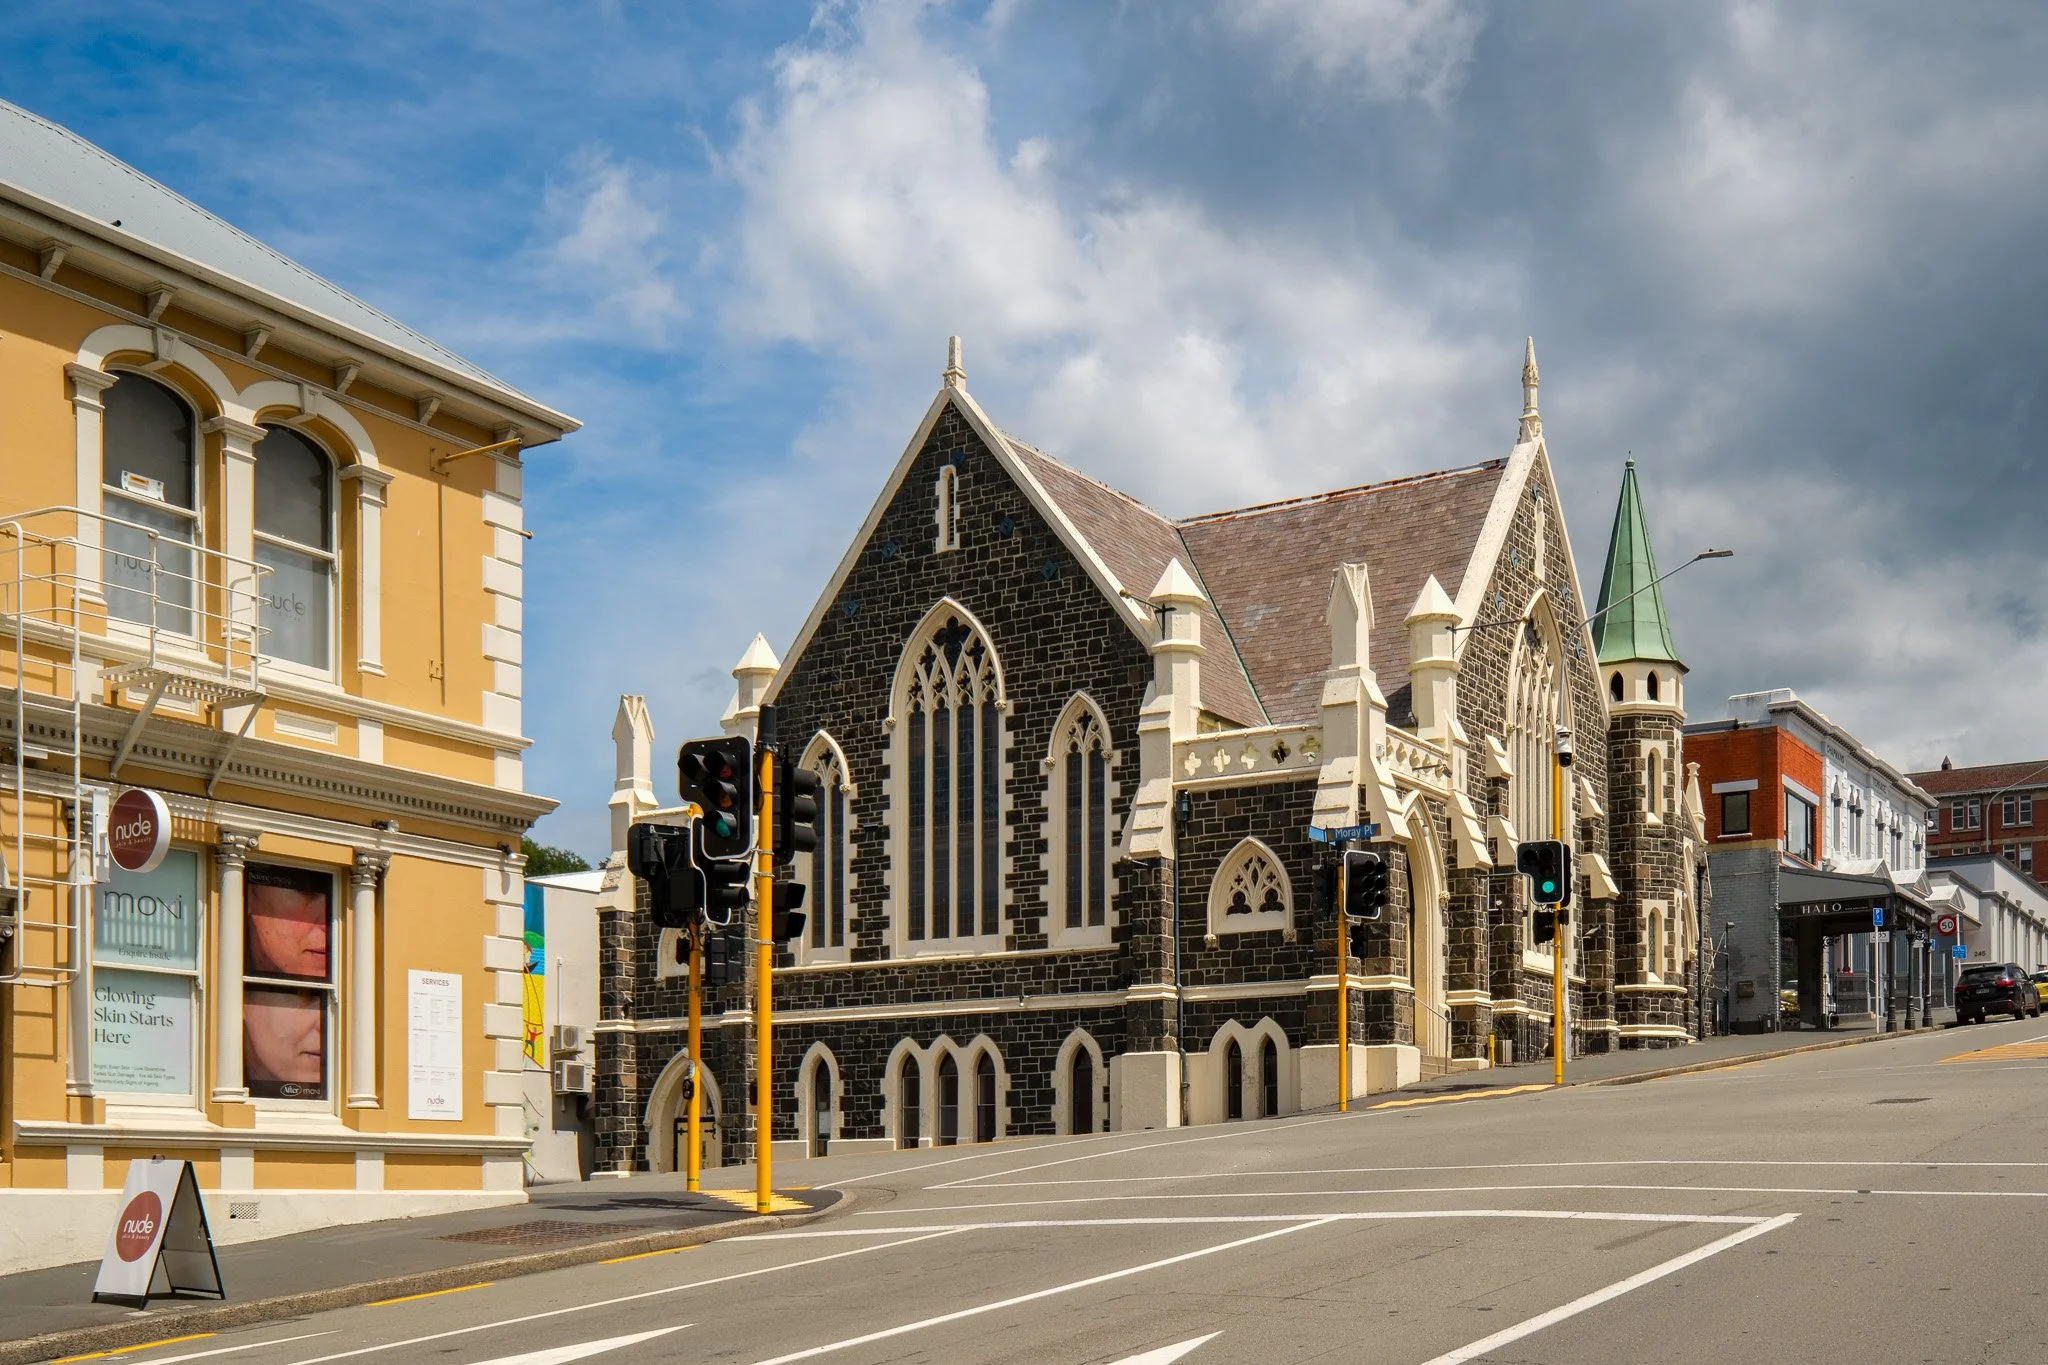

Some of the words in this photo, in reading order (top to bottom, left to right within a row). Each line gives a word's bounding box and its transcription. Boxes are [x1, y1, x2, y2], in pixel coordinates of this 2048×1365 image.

[115, 813, 152, 841] nude
[1335, 828, 1361, 839] Moray
[1364, 825, 1373, 835] Pl
[1802, 902, 1842, 915] HALO
[1941, 921, 1954, 930] 50
[118, 947, 148, 959] Enquire
[149, 949, 171, 961] Inside
[422, 977, 449, 986] SERVICES
[94, 986, 156, 1010] Glowing
[94, 1007, 126, 1023] Skin
[129, 1010, 174, 1027] Starts
[94, 1028, 131, 1044] Here
[284, 1085, 300, 1094] After
[426, 1095, 445, 1105] nude
[123, 1213, 154, 1234] nude
